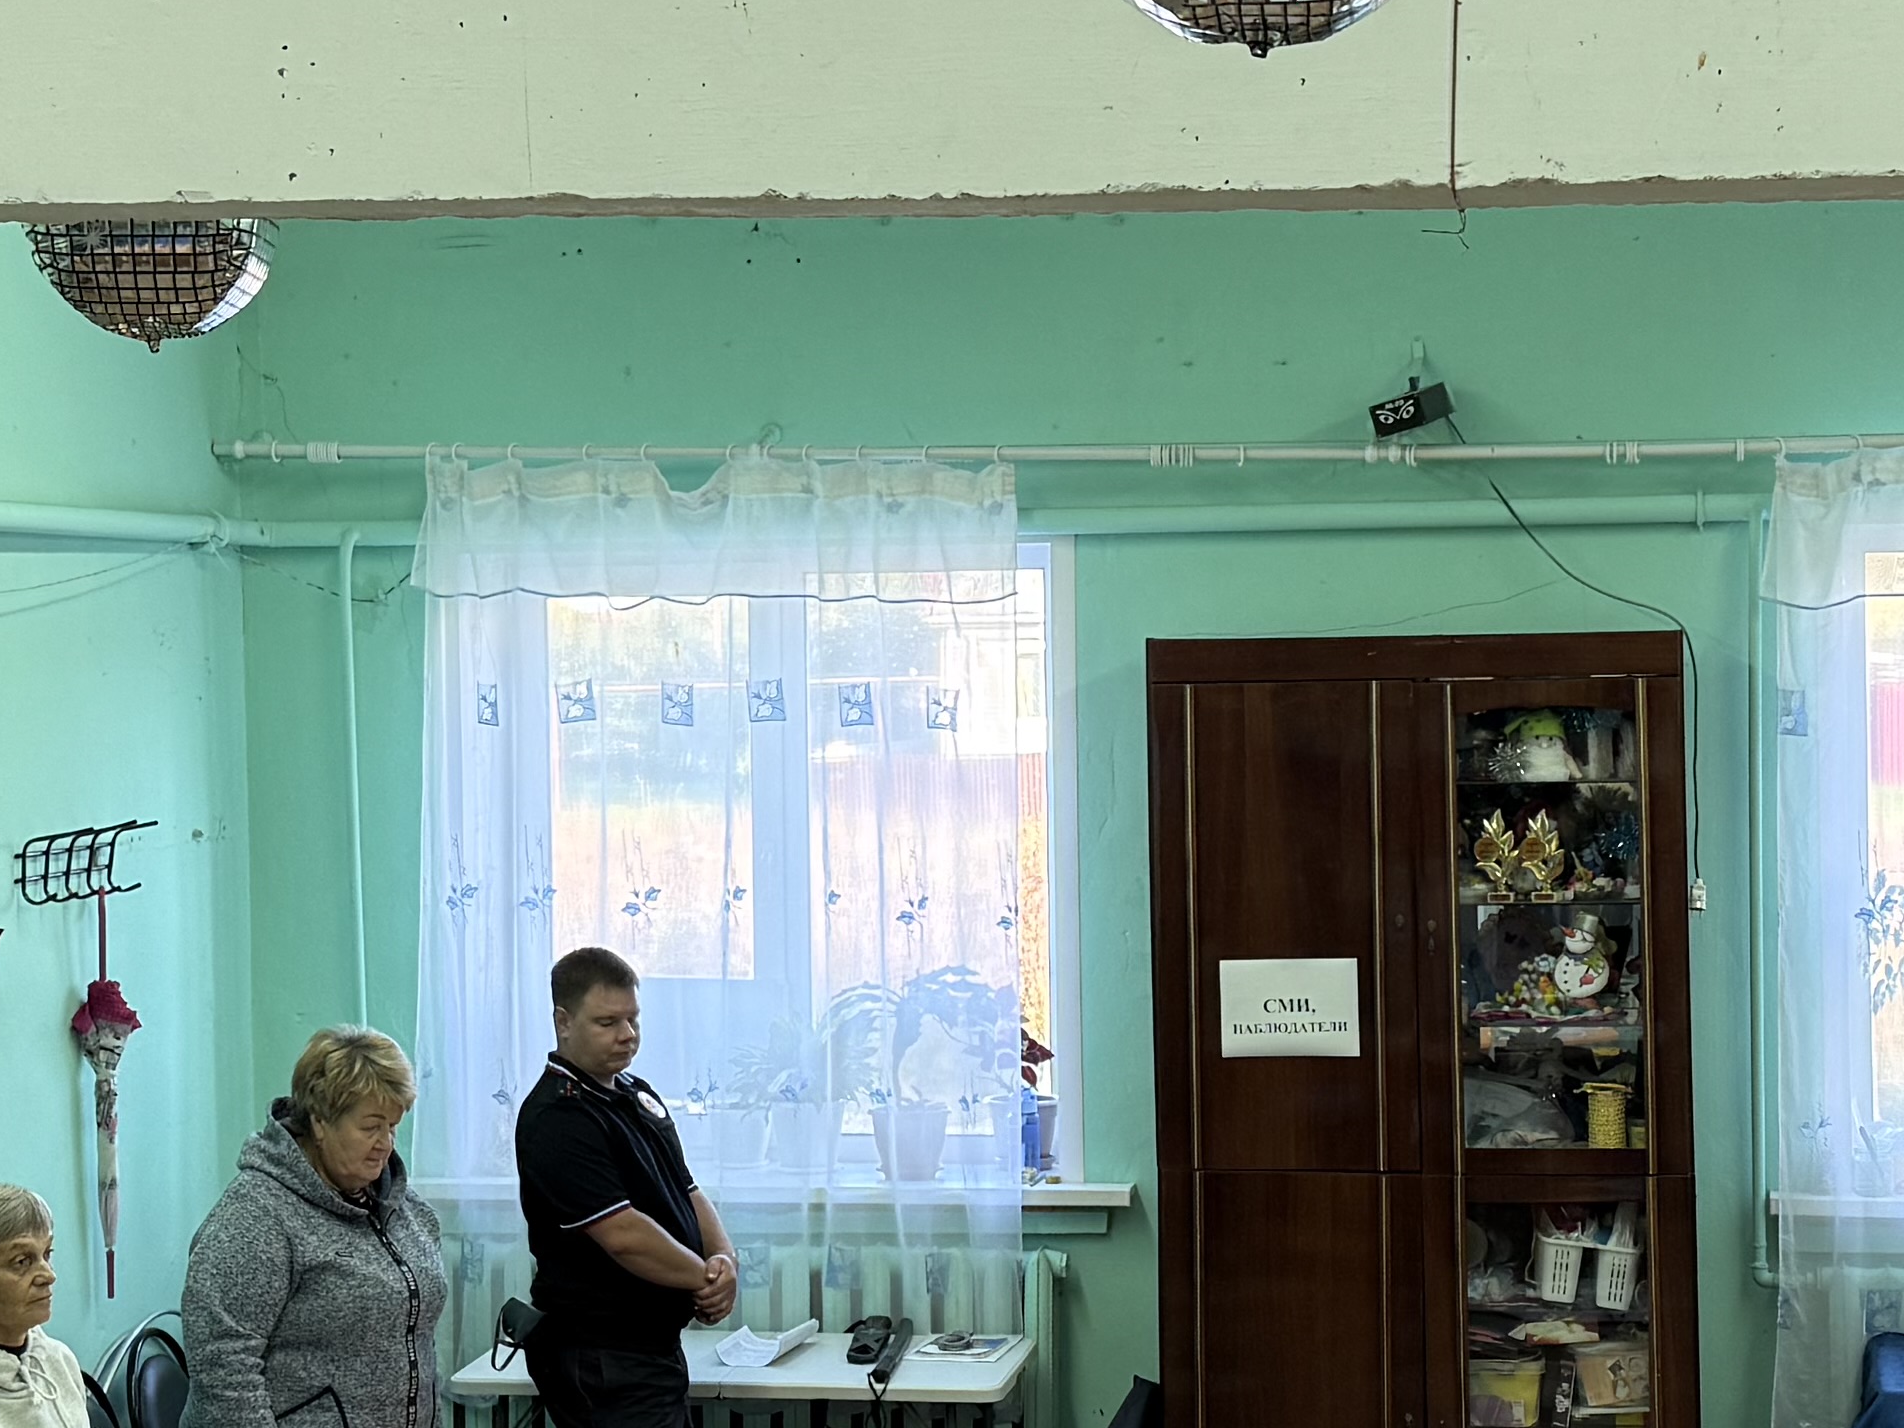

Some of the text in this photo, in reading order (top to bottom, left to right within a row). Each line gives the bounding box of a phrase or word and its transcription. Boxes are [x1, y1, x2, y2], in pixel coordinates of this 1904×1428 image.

[1263, 998, 1316, 1016] СМИ,
[1233, 1021, 1348, 1035] НАБЛЮДАТЕЛИ
[400, 1265, 417, 1290] NICE
